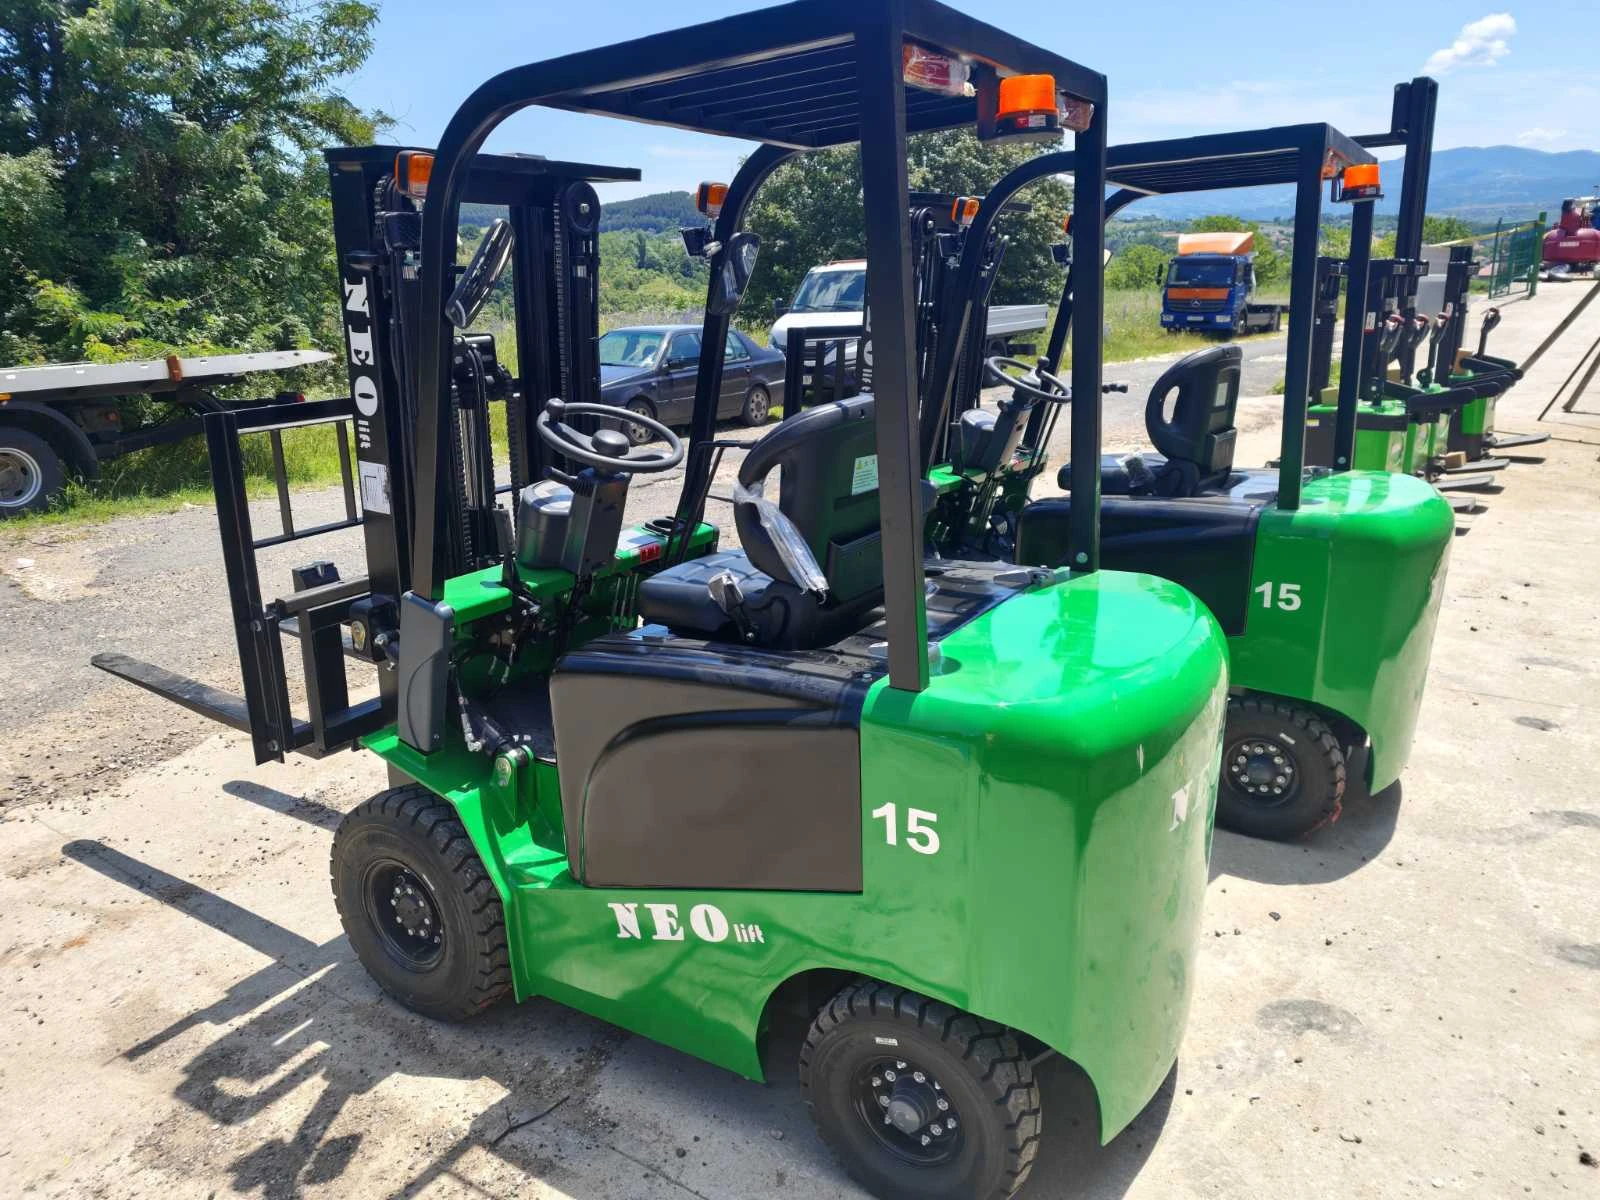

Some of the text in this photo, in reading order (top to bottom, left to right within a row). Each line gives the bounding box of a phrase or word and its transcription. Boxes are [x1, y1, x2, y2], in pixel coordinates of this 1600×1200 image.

[344, 277, 378, 449] NEO lift
[1254, 581, 1302, 611] 15
[872, 801, 940, 855] 15
[607, 902, 765, 944] NEO lift
